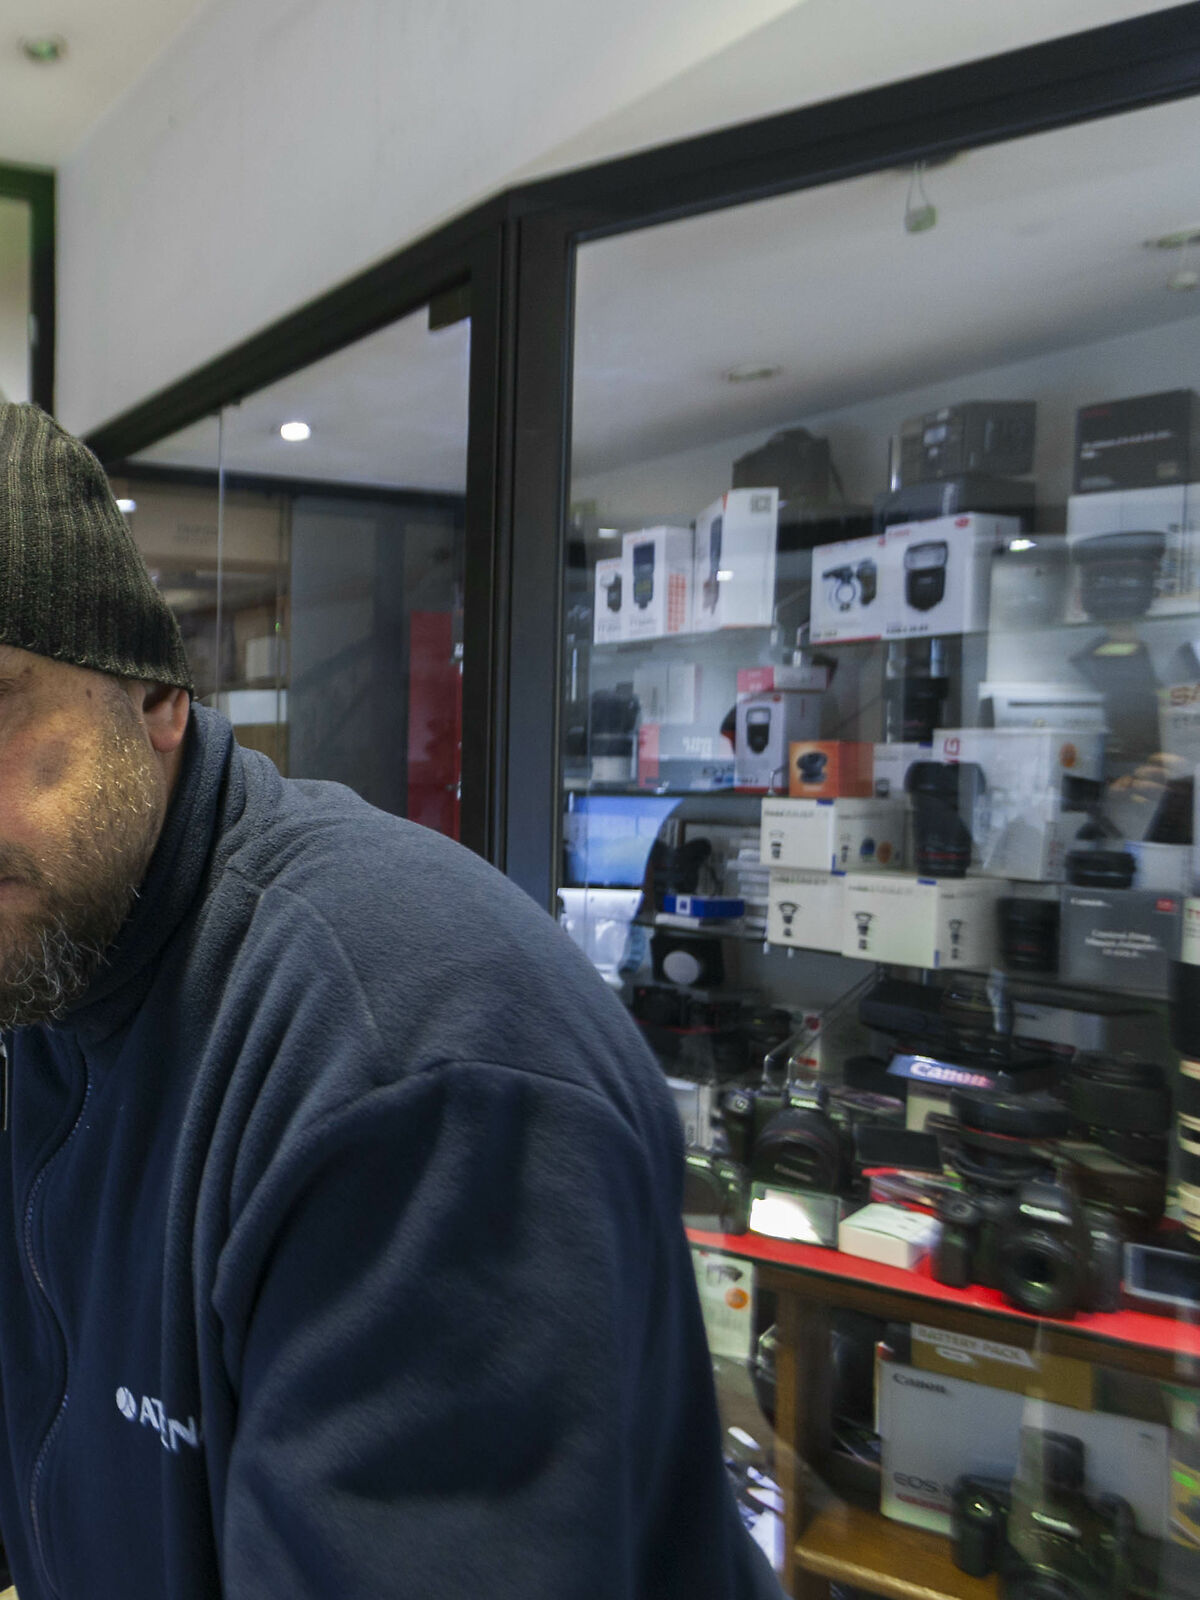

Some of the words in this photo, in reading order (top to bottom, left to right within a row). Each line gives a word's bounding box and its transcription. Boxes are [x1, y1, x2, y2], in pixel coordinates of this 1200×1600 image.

[910, 1062, 993, 1088] Canon
[918, 1326, 978, 1350] BATTERY
[983, 1341, 1027, 1362] PACK
[893, 1372, 947, 1395] Canon
[893, 1471, 938, 1493] EOS
